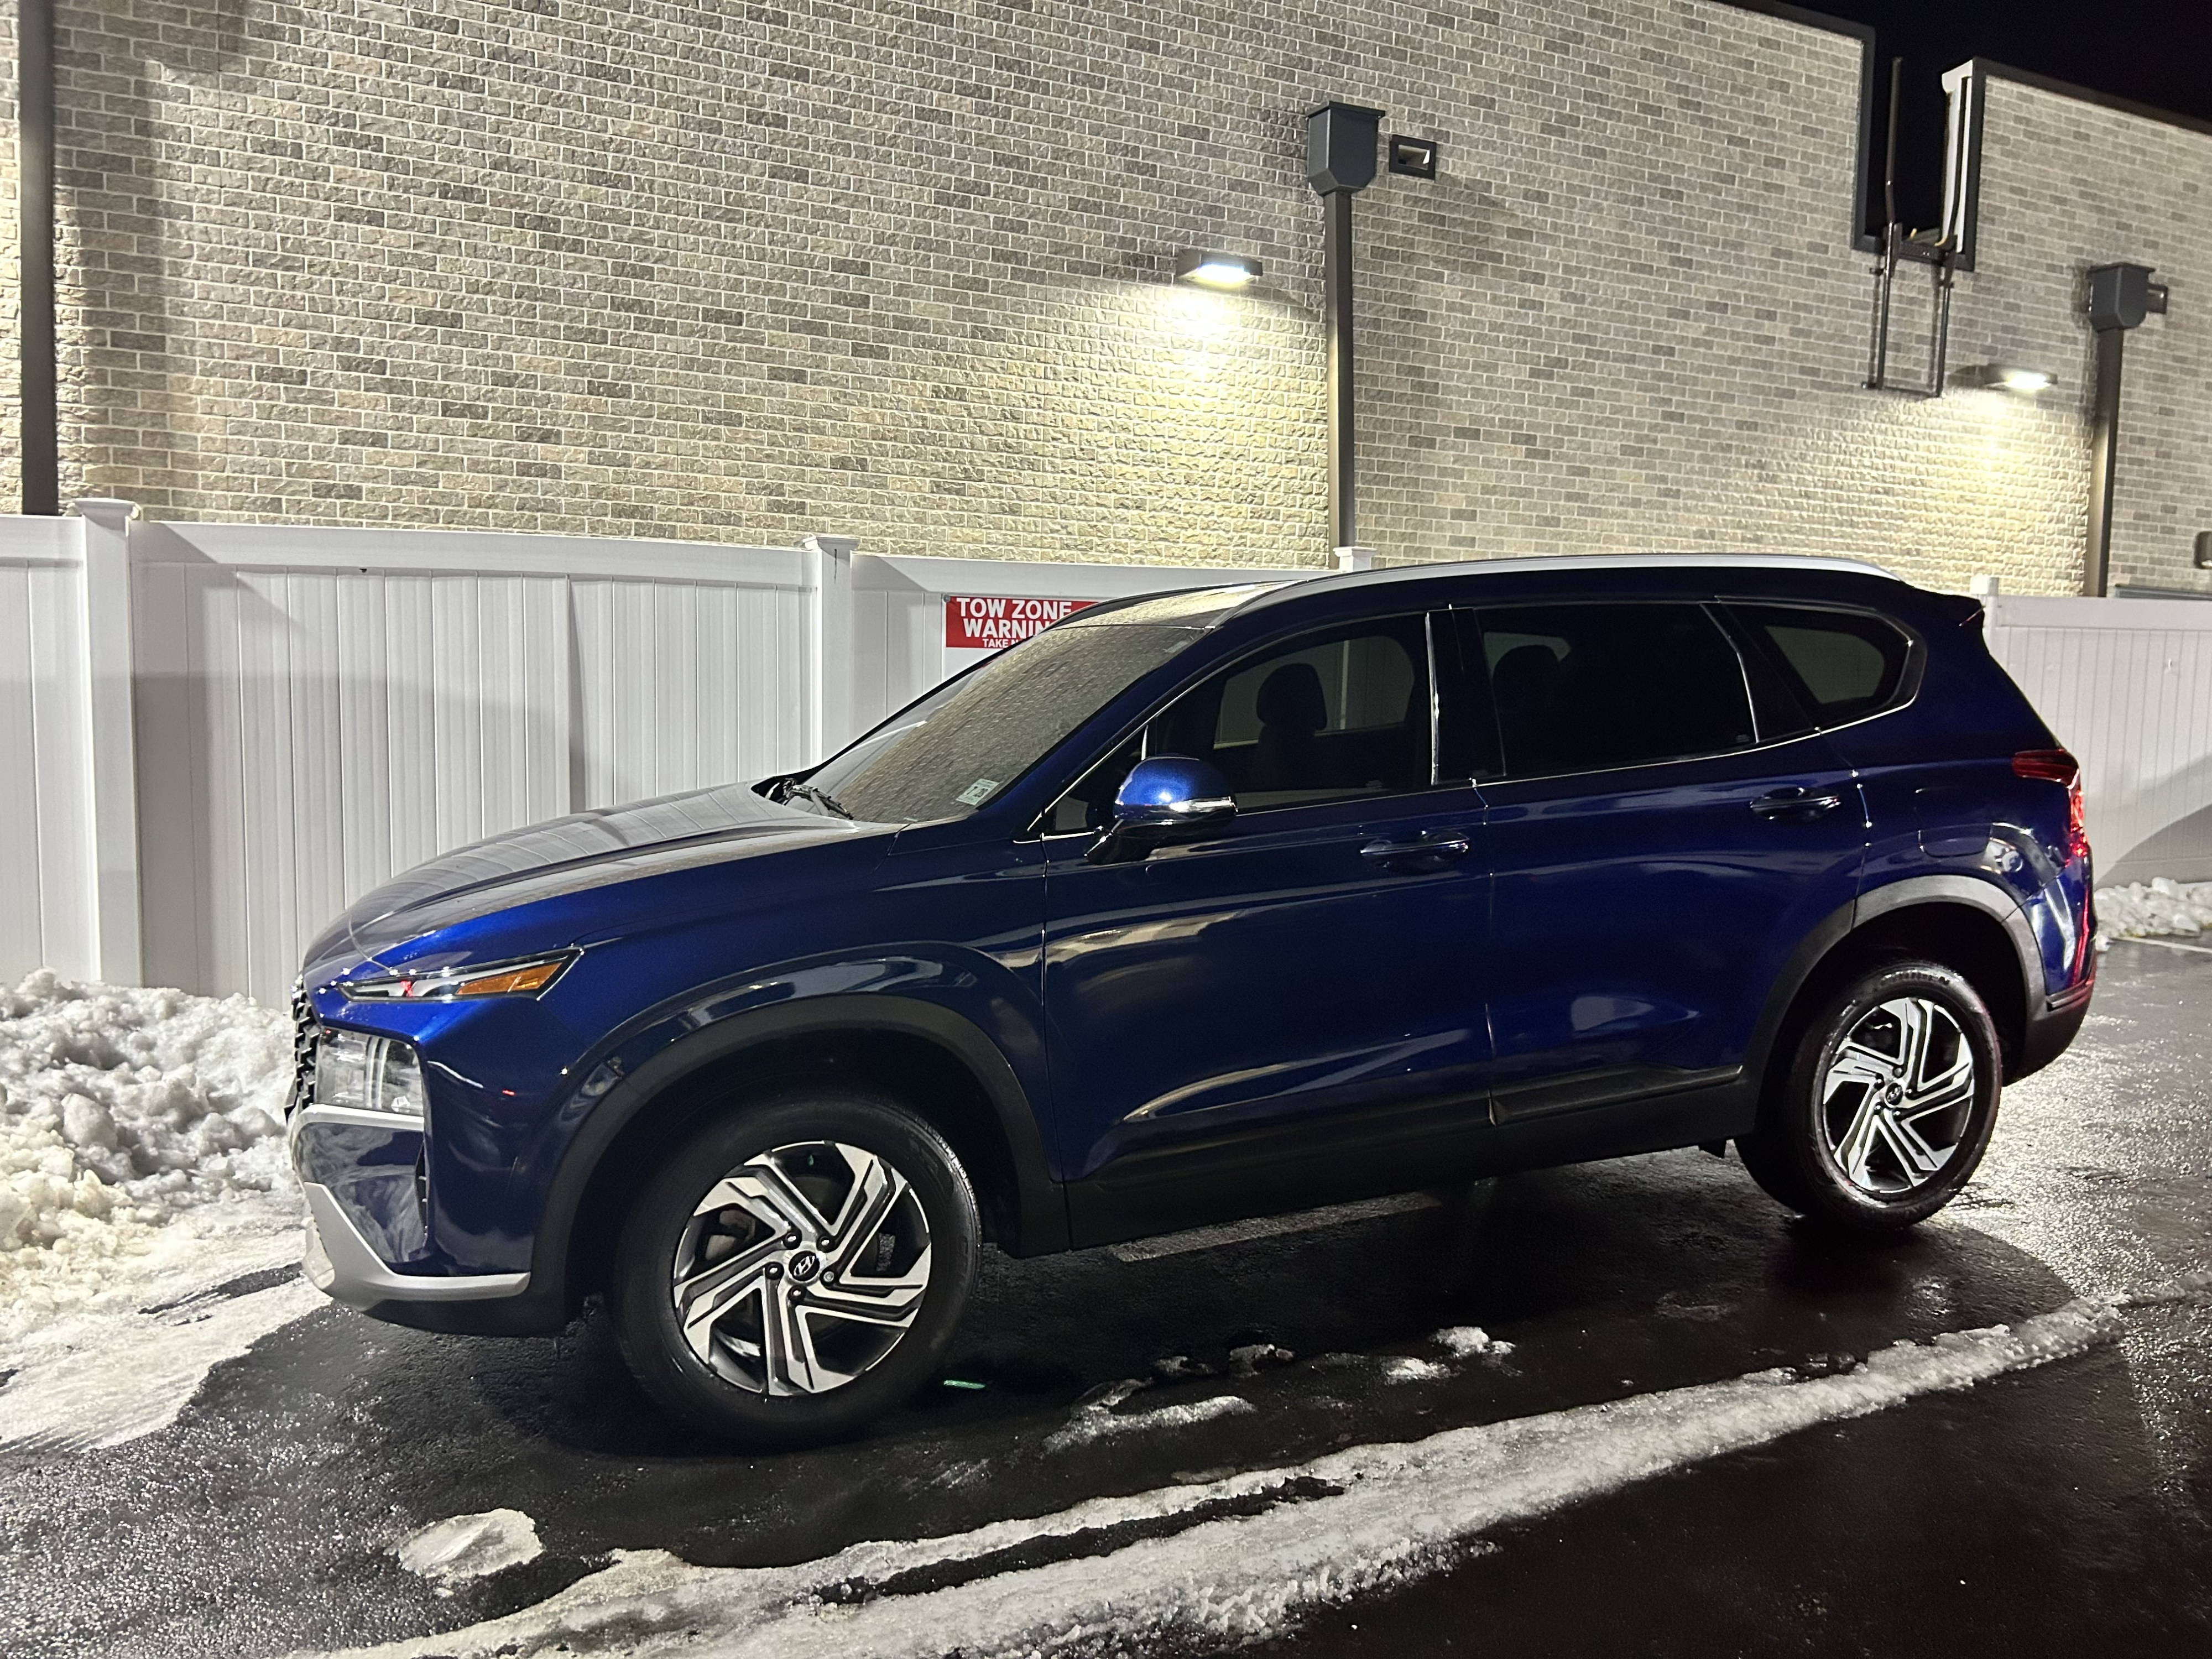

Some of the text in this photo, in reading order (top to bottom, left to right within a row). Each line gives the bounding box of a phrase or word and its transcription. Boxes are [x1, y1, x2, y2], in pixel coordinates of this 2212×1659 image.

[956, 597, 1072, 620] TOW ZONE
[963, 618, 1050, 639] WARNIN
[982, 638, 1009, 648] TAKE
